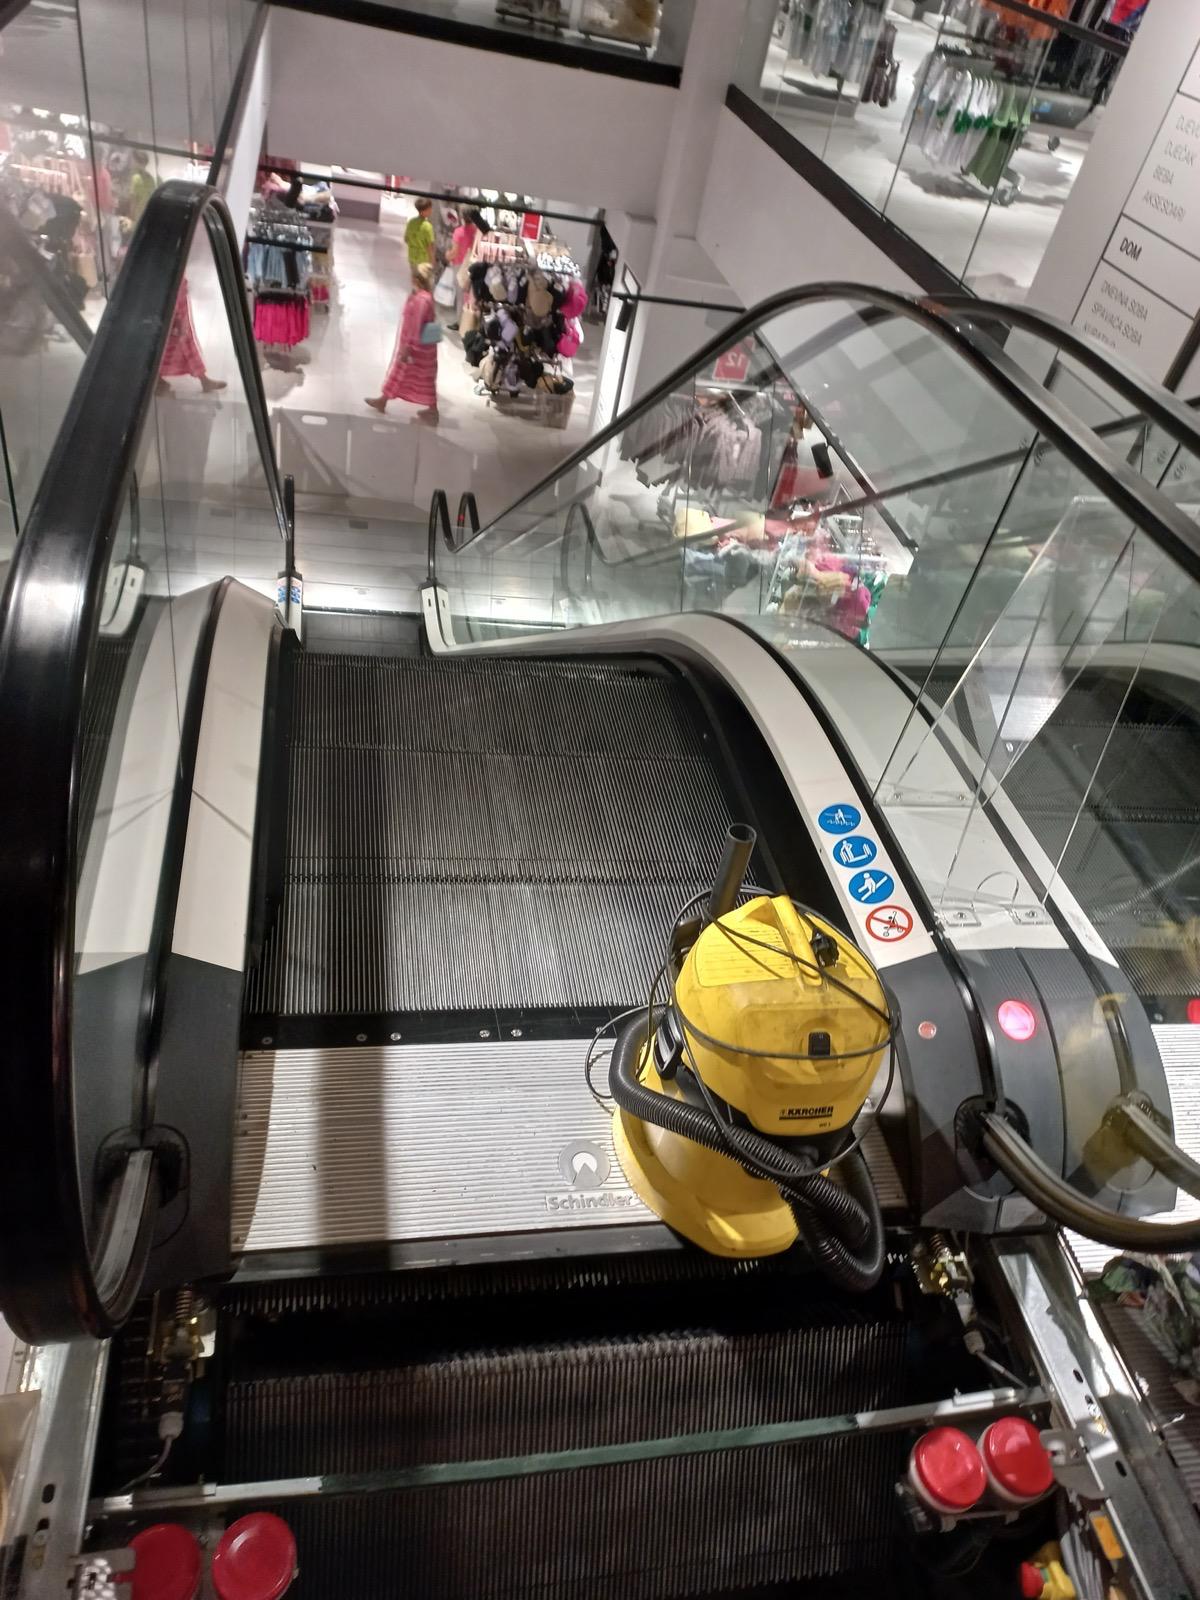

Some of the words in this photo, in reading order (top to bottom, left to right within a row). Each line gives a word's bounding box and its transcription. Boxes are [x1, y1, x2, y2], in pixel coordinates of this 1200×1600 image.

[1120, 237, 1142, 261] DOM
[1128, 299, 1148, 321] SOBA
[1121, 324, 1142, 346] SOBA
[547, 1192, 633, 1210] Schindler
